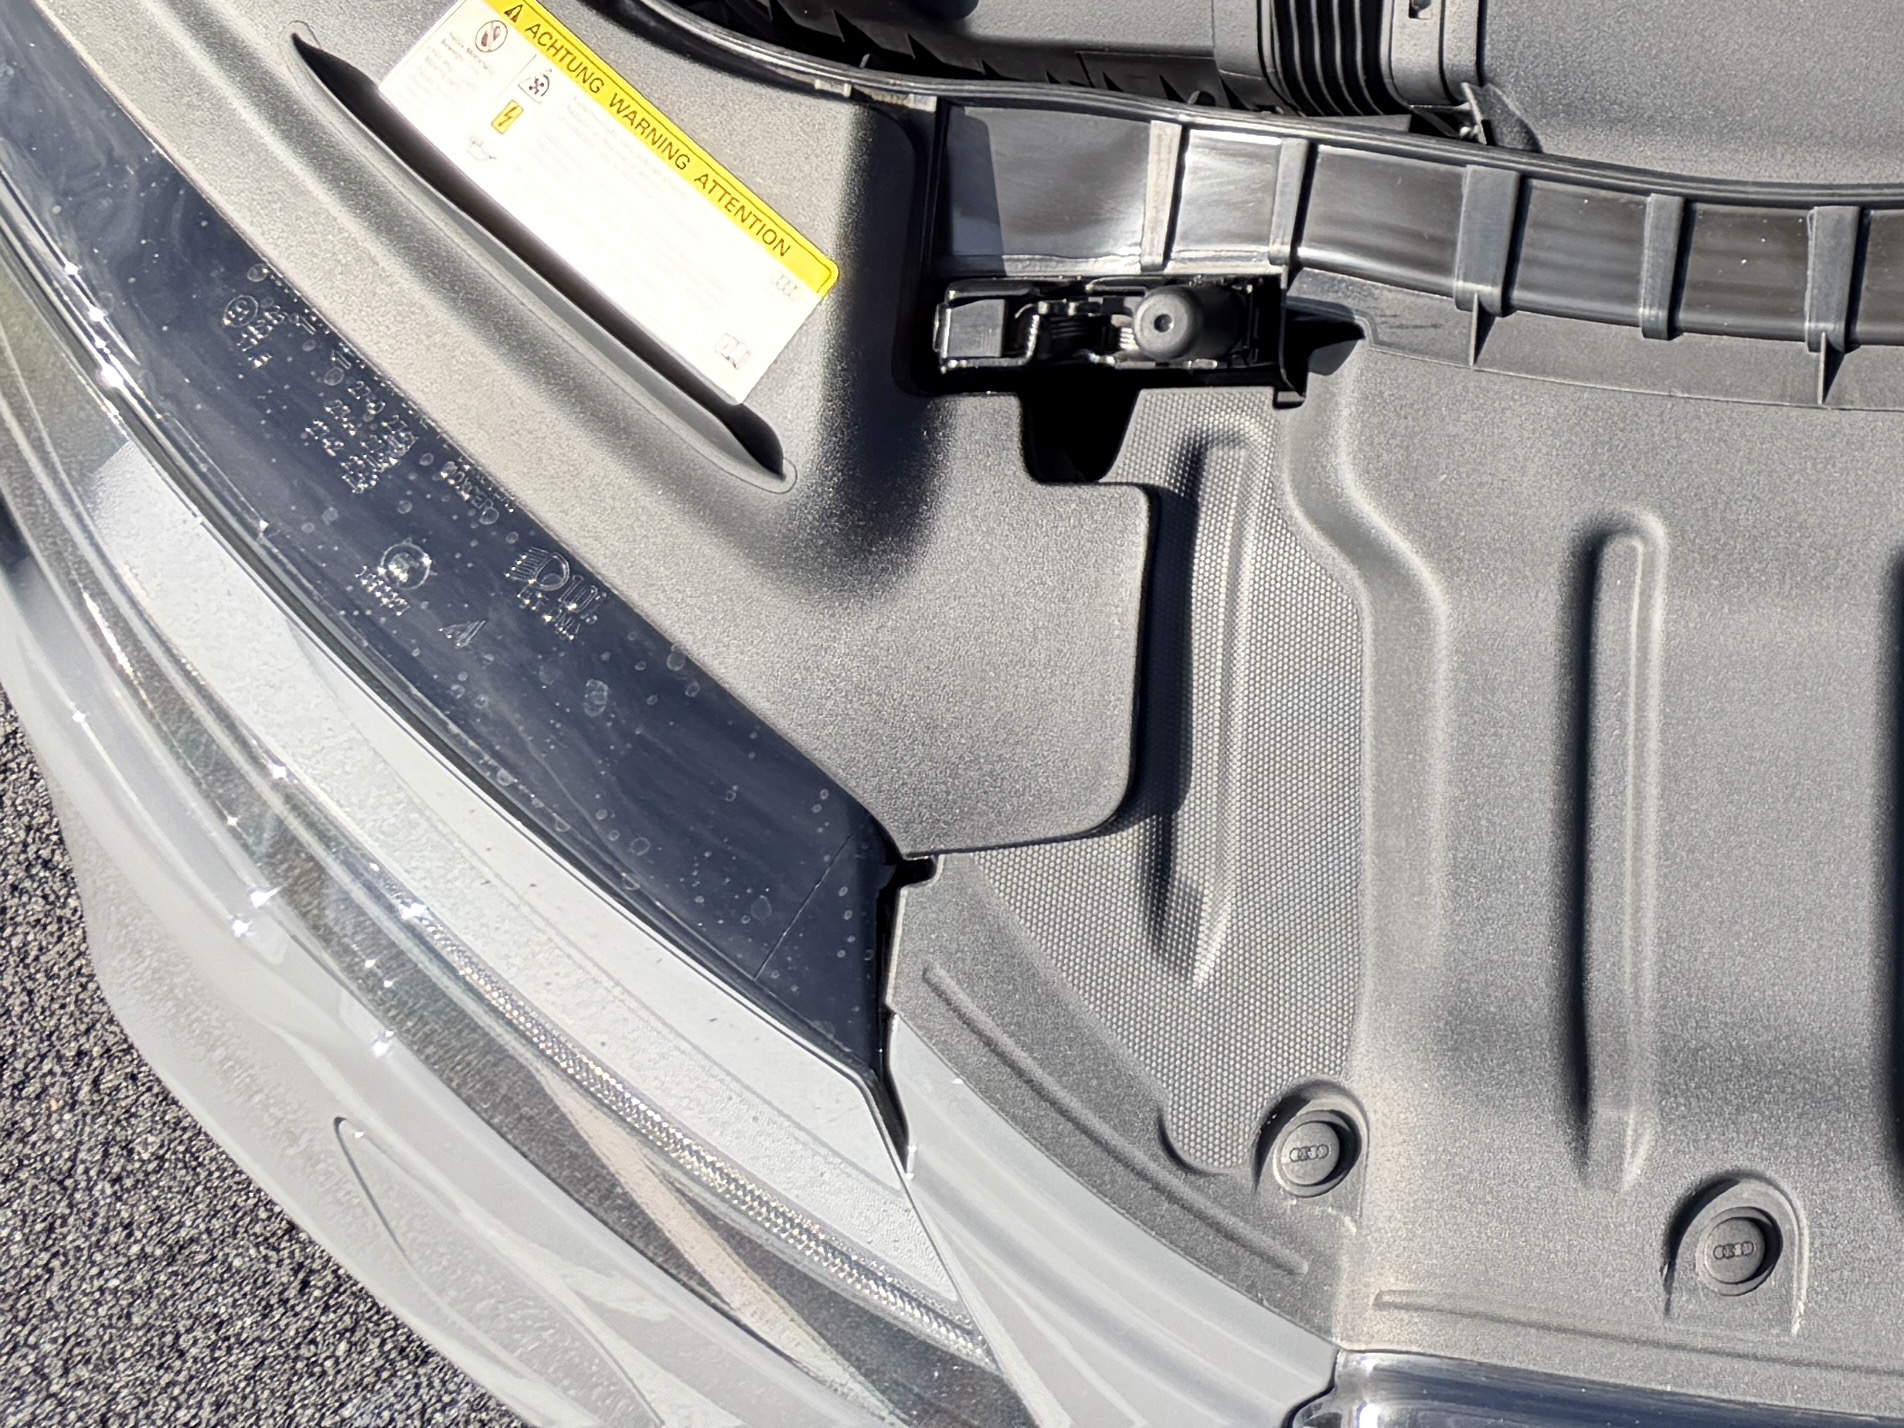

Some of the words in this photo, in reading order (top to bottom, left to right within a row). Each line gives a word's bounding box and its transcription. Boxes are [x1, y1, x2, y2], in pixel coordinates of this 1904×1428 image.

[524, 21, 606, 96] ACHTUNG
[608, 92, 691, 172] WARNING
[693, 171, 790, 259] ATTENTION
